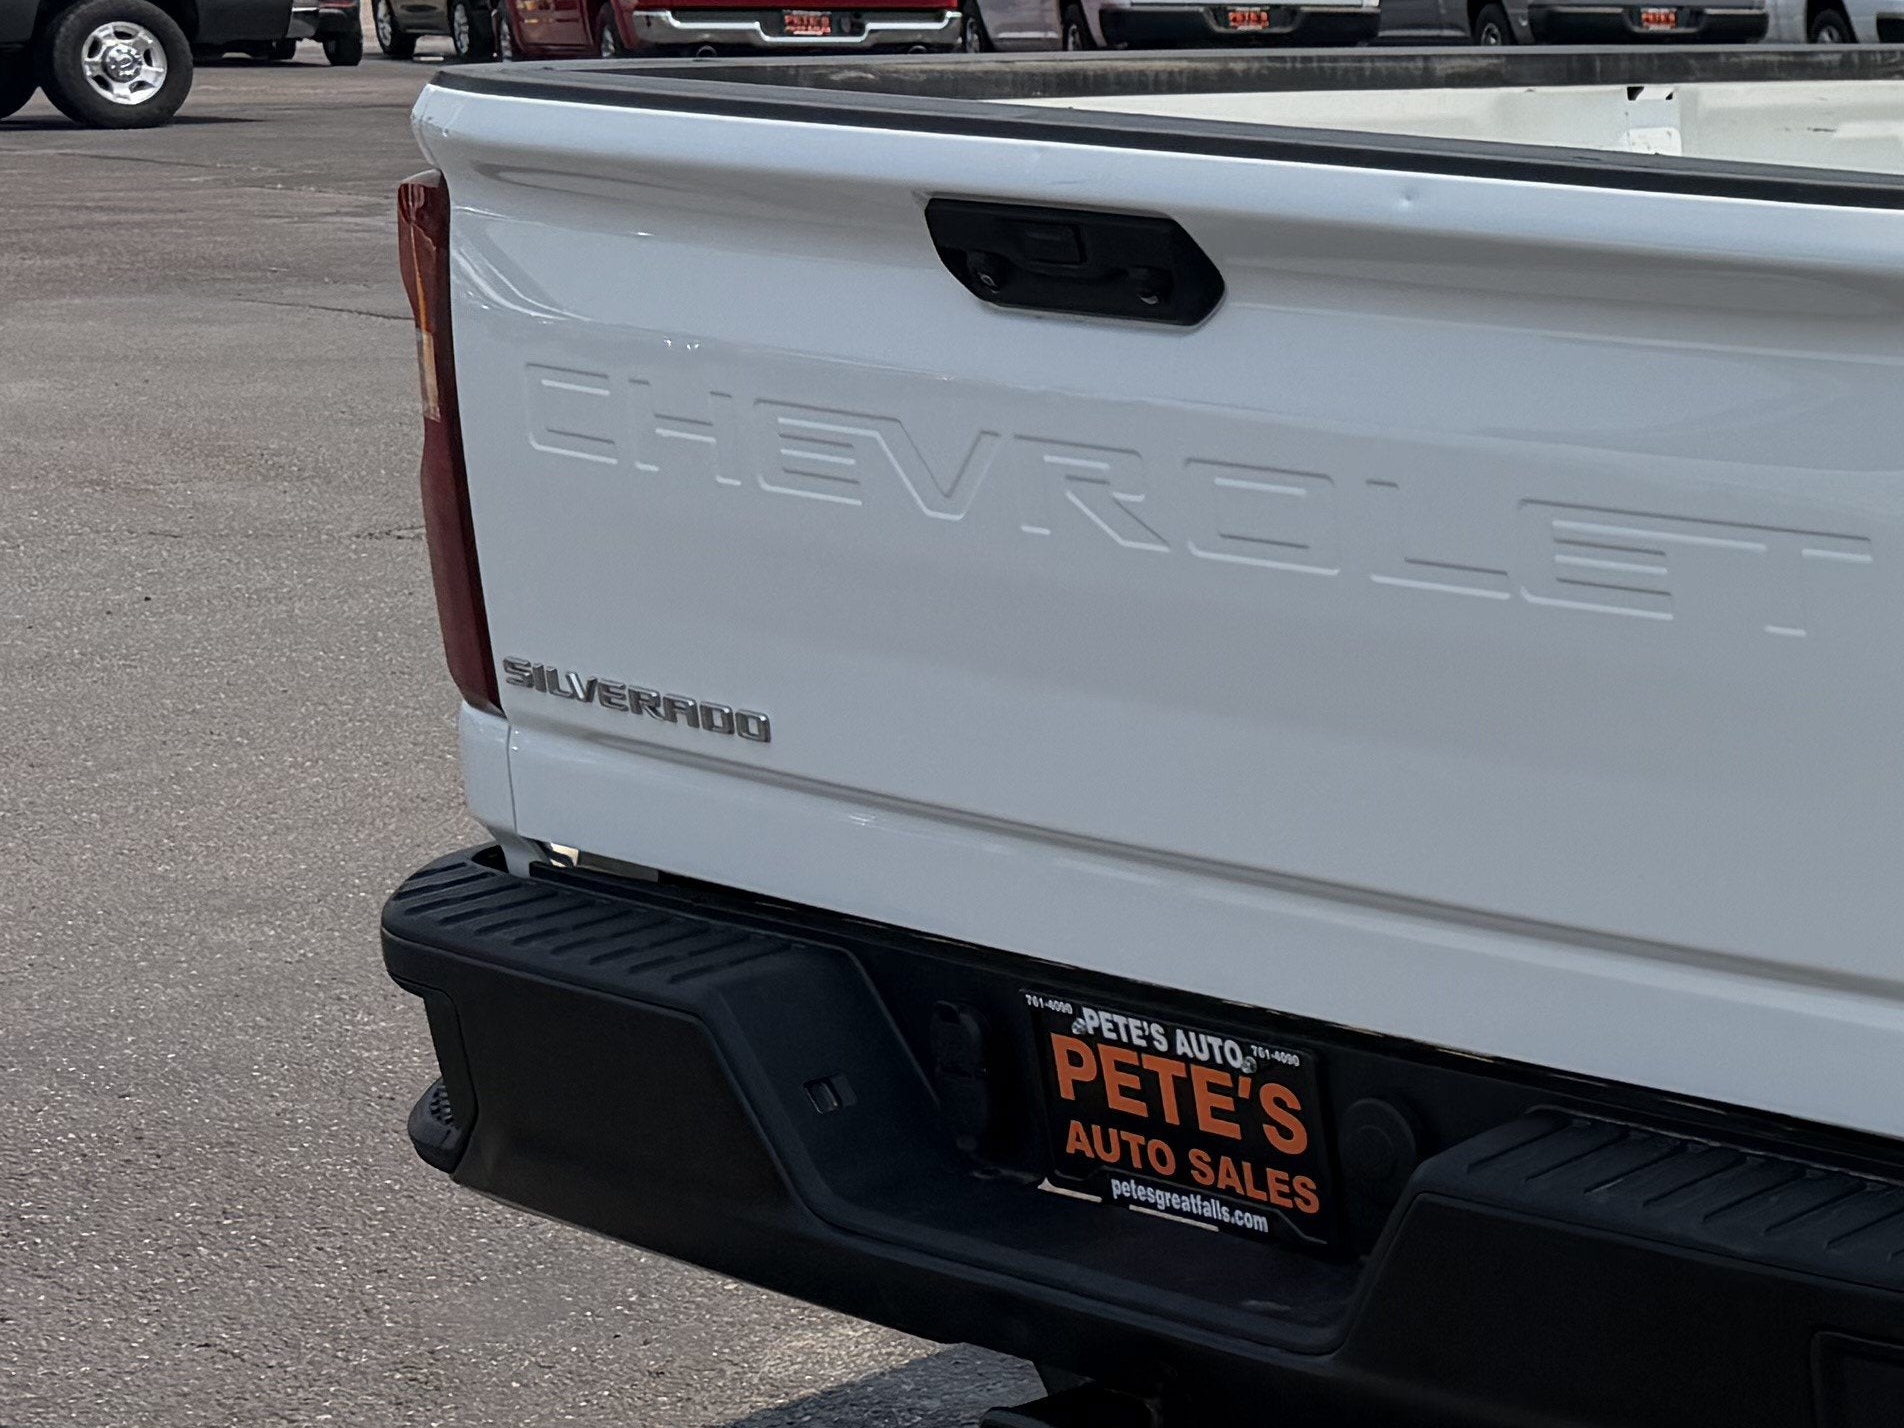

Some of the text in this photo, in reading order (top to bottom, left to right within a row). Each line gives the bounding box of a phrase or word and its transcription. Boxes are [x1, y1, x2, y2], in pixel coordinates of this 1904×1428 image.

[524, 360, 1874, 637] CHEVROLET
[502, 655, 772, 743] SILVERADO
[1081, 1006, 1244, 1070] PETE'S AUTO
[1050, 1032, 1308, 1155] PETE'S
[1066, 1119, 1320, 1215] AUTO SALES
[1111, 1177, 1269, 1233] petesgreatfalls.com
